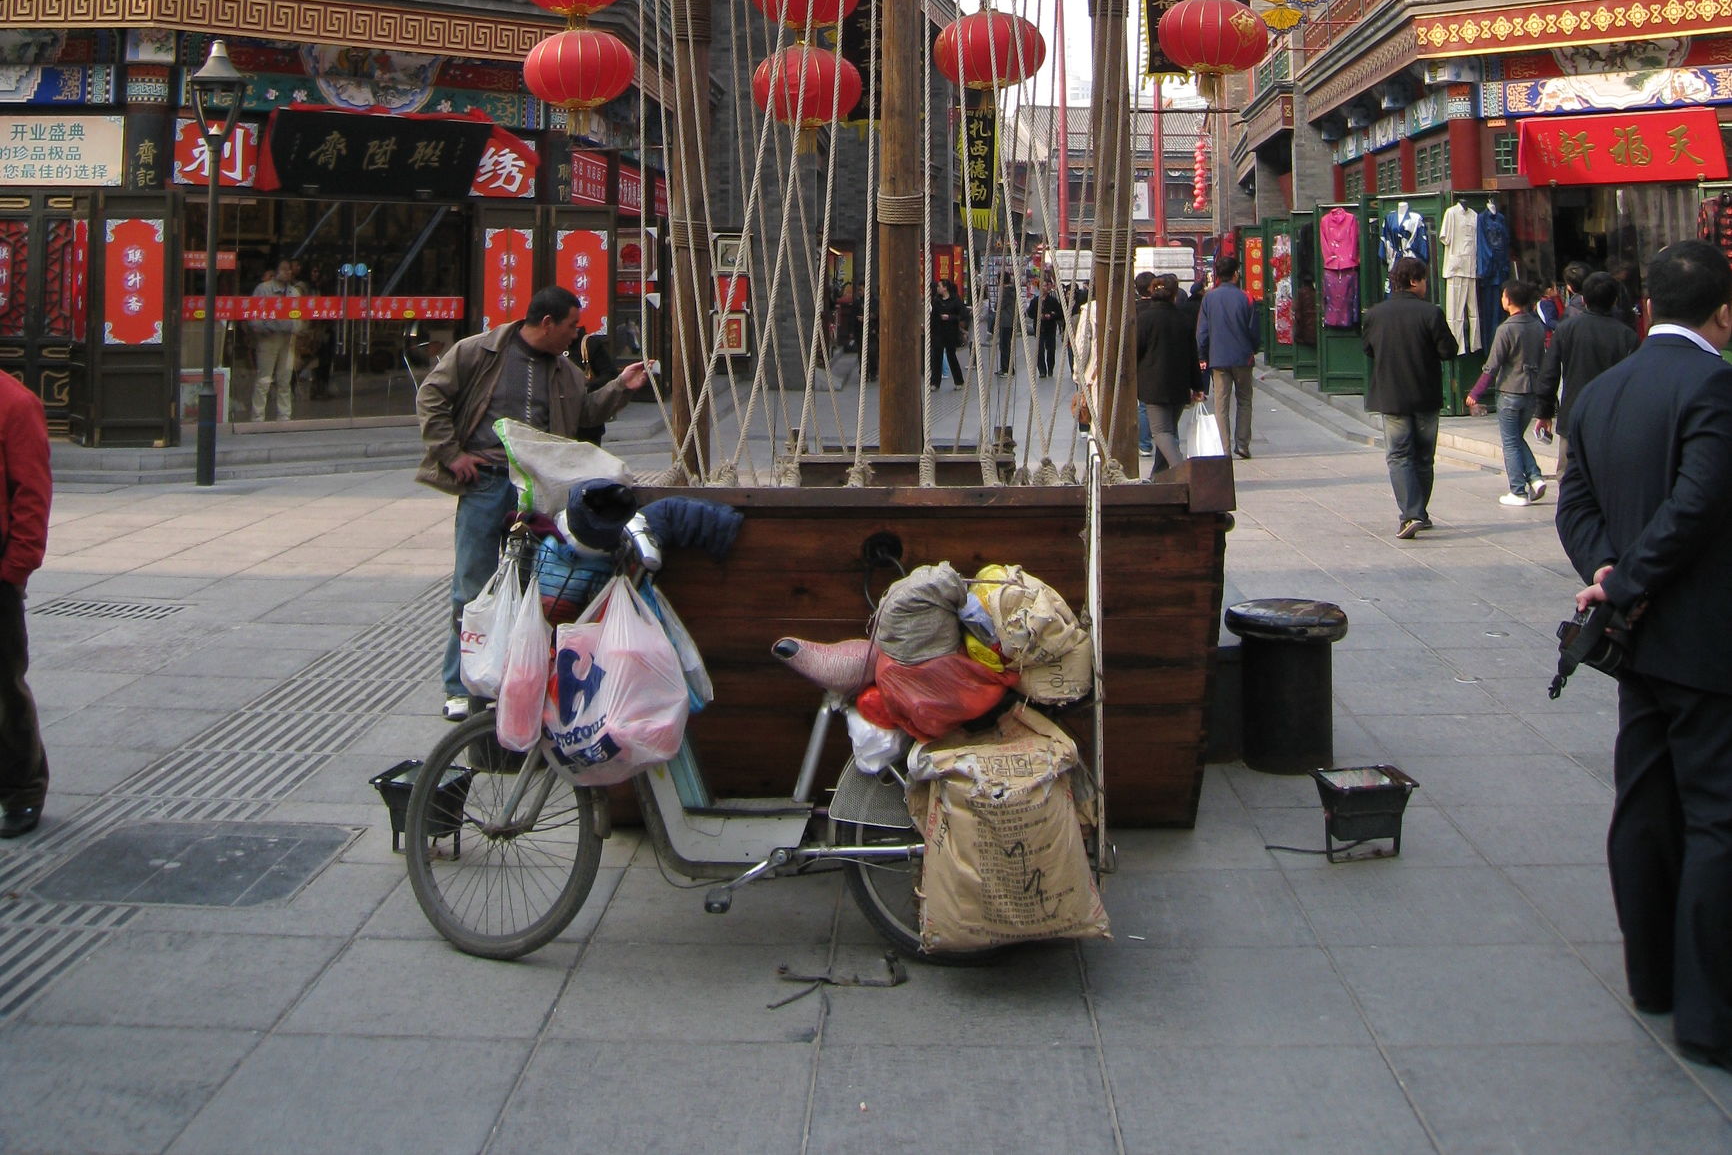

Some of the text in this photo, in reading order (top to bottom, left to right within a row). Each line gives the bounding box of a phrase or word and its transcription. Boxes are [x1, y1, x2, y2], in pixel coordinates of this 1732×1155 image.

[10, 122, 86, 142] 开业盛典
[3, 163, 108, 180] 您最佳的选择
[478, 147, 526, 193] 绣
[969, 119, 991, 202] 扎西德勒
[127, 249, 143, 312] 联升斋
[460, 630, 487, 645] KFC
